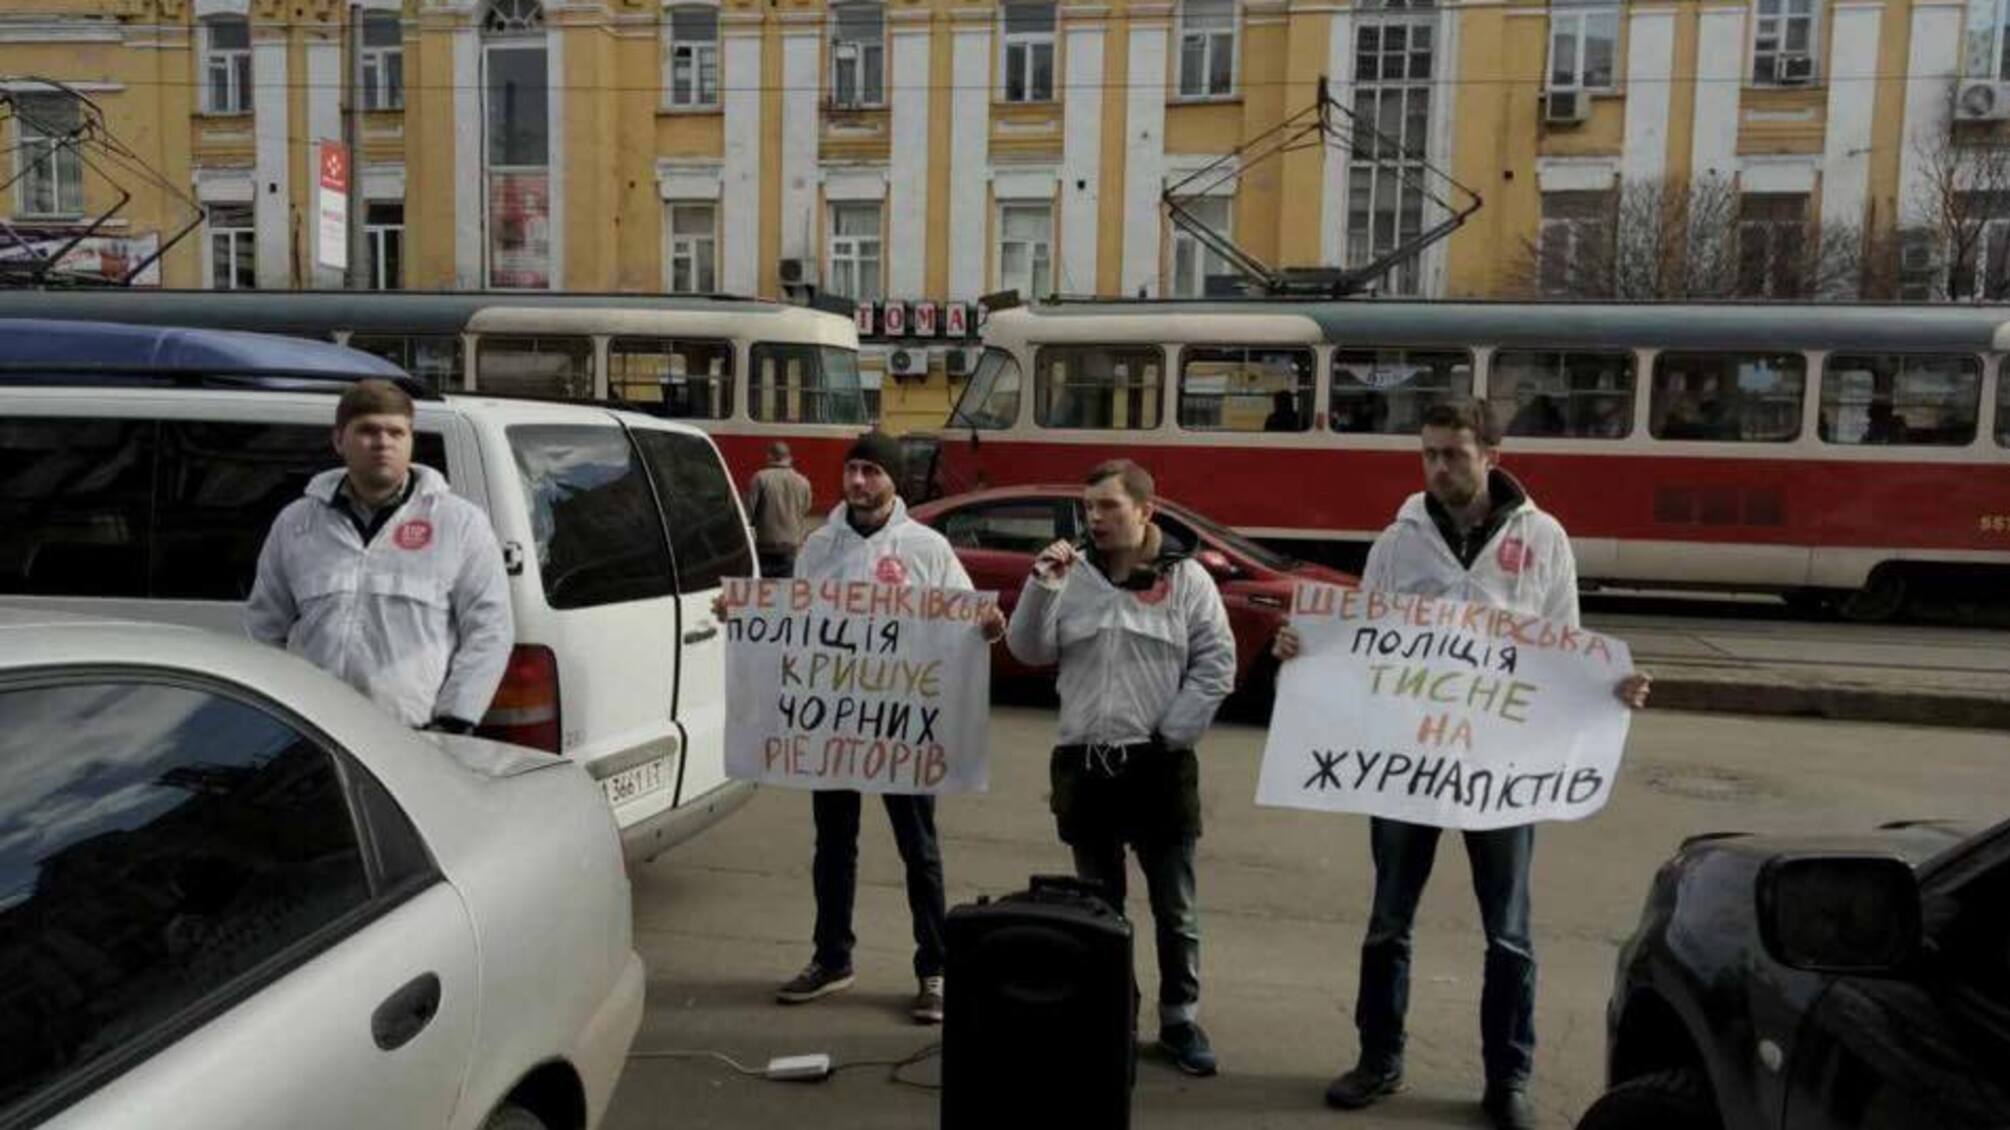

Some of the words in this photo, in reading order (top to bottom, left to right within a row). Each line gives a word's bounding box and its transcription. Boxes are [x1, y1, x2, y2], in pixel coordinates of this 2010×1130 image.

[724, 579, 993, 623] ШЕВЧЕНКІВСЬК
[1295, 583, 1612, 664] ШЕВЧЕНКІВСЬКА
[727, 611, 901, 654] ПОЛІЦІЯ
[1351, 626, 1517, 673] ПОЛІЦІЯ
[781, 652, 944, 698] КРИШУЄ
[1369, 664, 1538, 723] ТИСНЕ
[778, 694, 941, 746] ЧОРНИХ
[1416, 713, 1474, 750] НА
[1302, 749, 1603, 814] ЖУРНАЛІСТІВ
